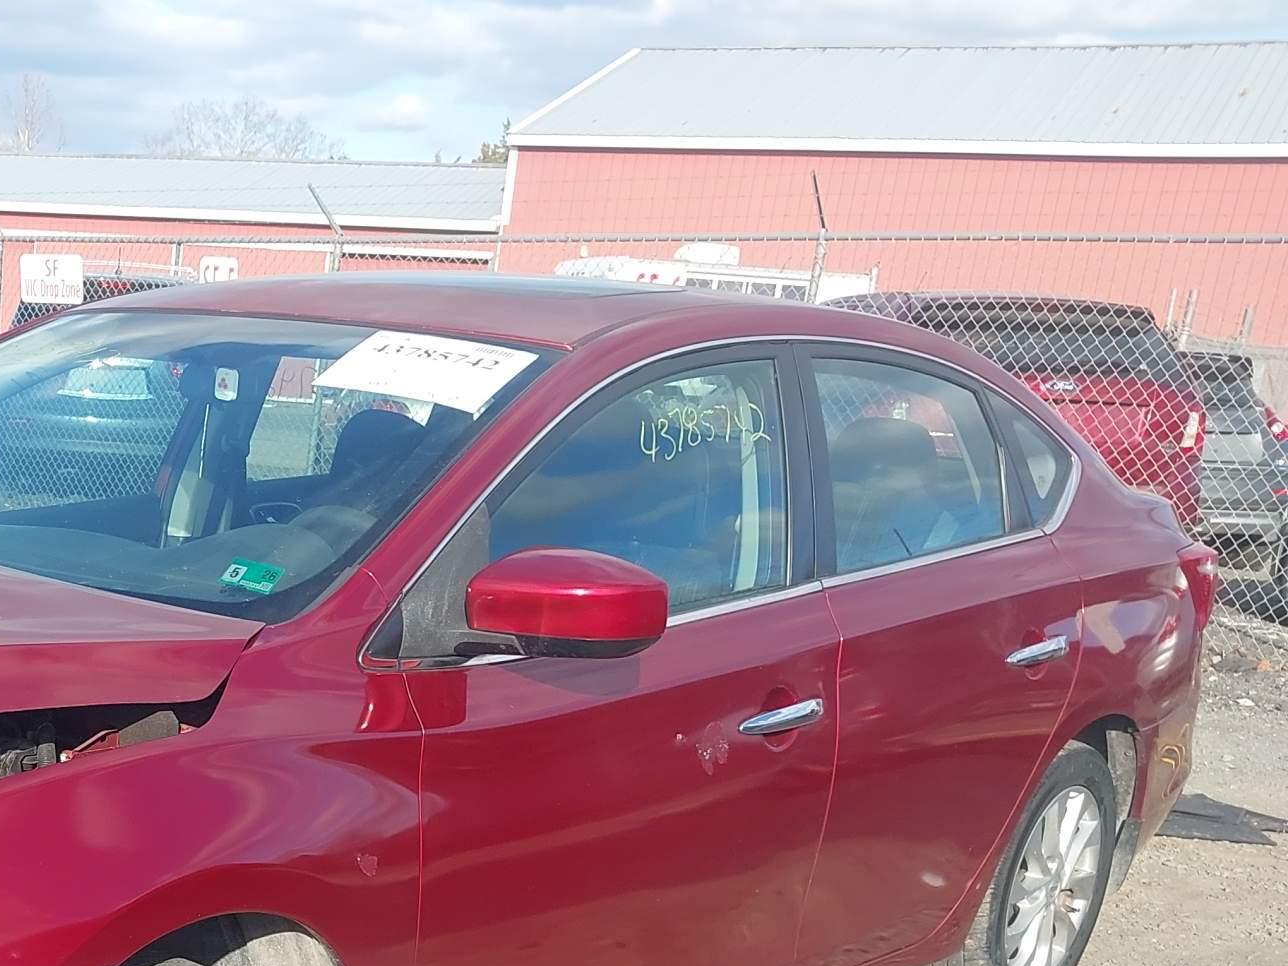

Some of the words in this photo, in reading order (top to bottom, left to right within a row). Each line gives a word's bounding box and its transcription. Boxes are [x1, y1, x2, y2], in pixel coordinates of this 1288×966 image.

[45, 259, 59, 277] SF
[60, 279, 82, 298] Zone
[372, 342, 501, 371] 43785742
[640, 402, 772, 464] 43785742
